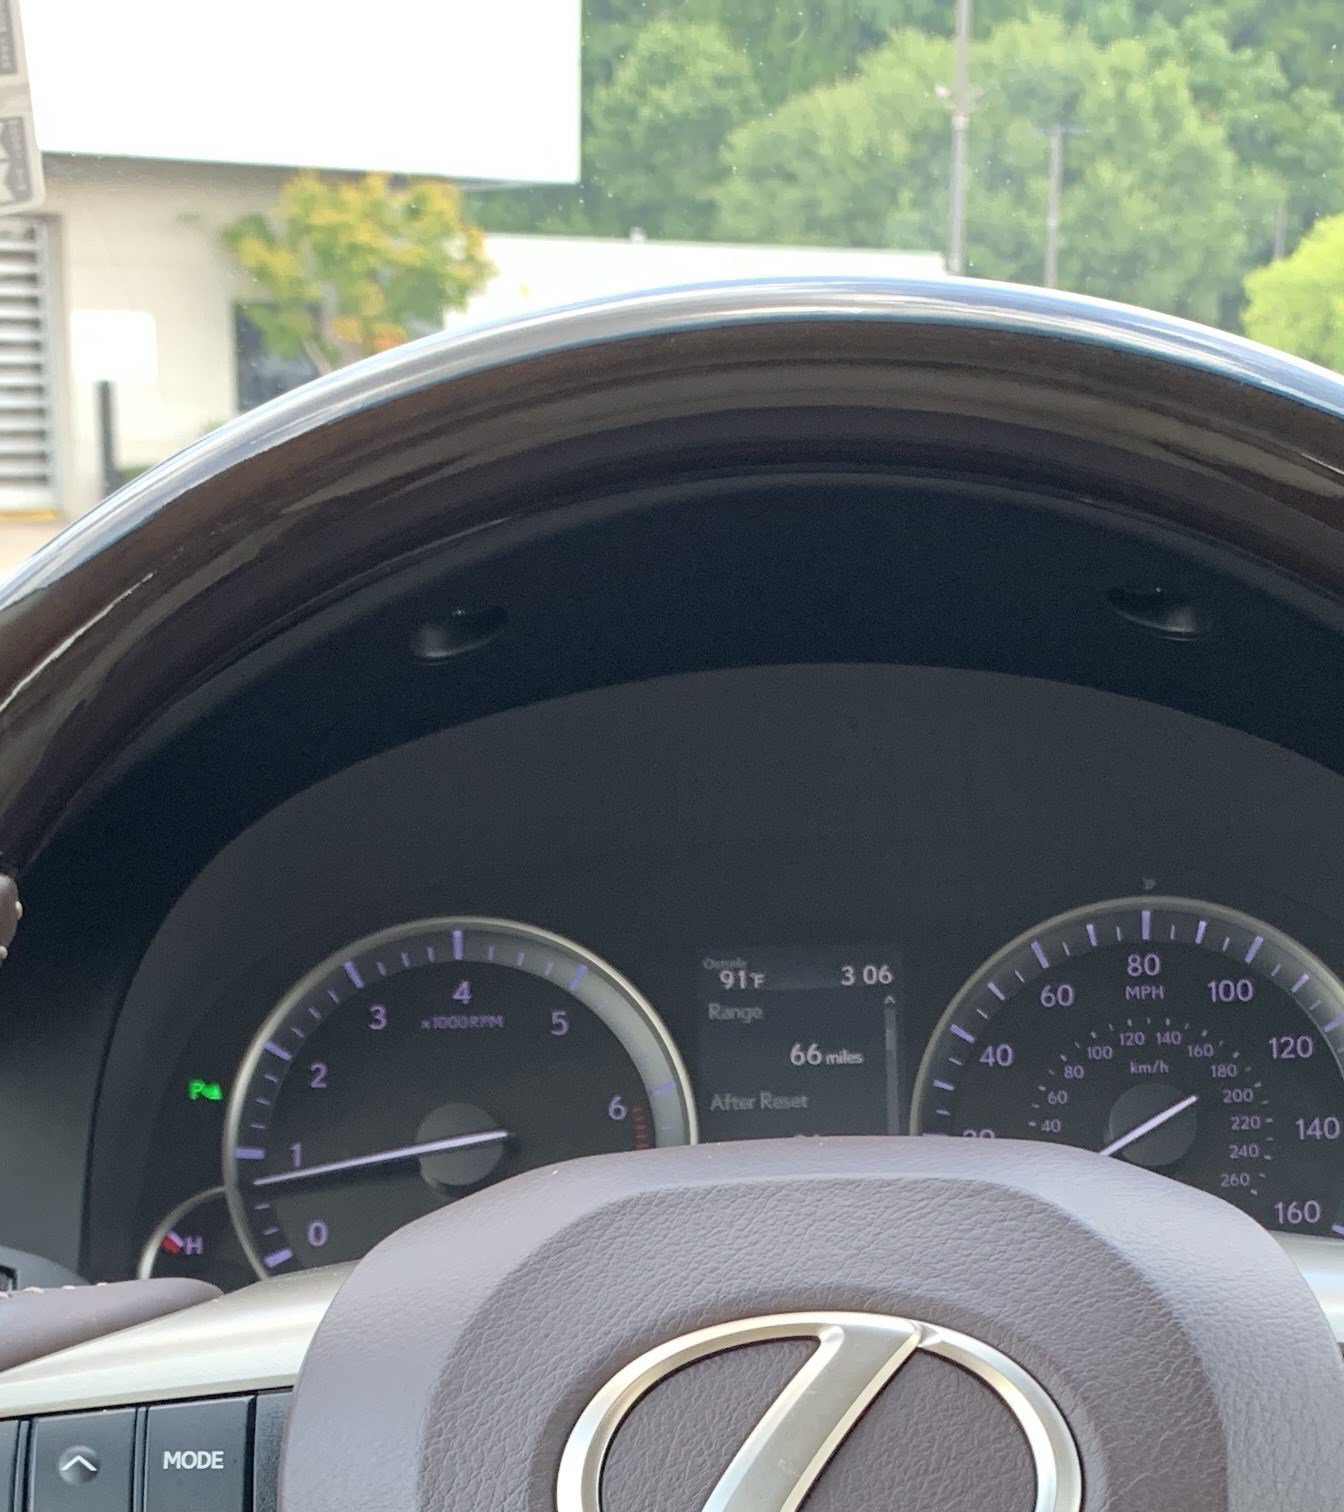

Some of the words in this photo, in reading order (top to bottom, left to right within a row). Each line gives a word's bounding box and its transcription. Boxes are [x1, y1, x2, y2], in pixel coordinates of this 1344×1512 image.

[1126, 953, 1161, 976] 80
[452, 980, 472, 1005] 4
[1039, 983, 1075, 1008] 60
[1125, 985, 1164, 1000] MPH
[1207, 978, 1254, 1003] 100
[368, 1005, 388, 1030] 3
[550, 1011, 569, 1036] 5
[708, 1003, 763, 1023] Range
[1119, 1031, 1145, 1046] 120
[1156, 1030, 1181, 1045] 140
[1268, 1034, 1313, 1059] 120
[790, 1043, 822, 1066] 66
[825, 1049, 864, 1065] miles
[979, 1043, 1014, 1067] 40
[309, 1063, 328, 1089] 2
[1063, 1065, 1084, 1079] 80
[1129, 1061, 1169, 1075] km/h
[1210, 1063, 1238, 1078] 180
[1047, 1090, 1068, 1104] 60
[1222, 1087, 1254, 1102] 200
[608, 1096, 628, 1120] 6
[1041, 1118, 1062, 1133] 40
[1231, 1115, 1261, 1130] 220
[1294, 1115, 1340, 1140] 140
[290, 1143, 304, 1168] 1
[1229, 1143, 1259, 1159] 240
[1220, 1172, 1251, 1187] 260
[1274, 1200, 1321, 1225] 160
[306, 1221, 329, 1246] 0
[184, 1237, 203, 1254] H
[163, 1451, 224, 1469] MODE
